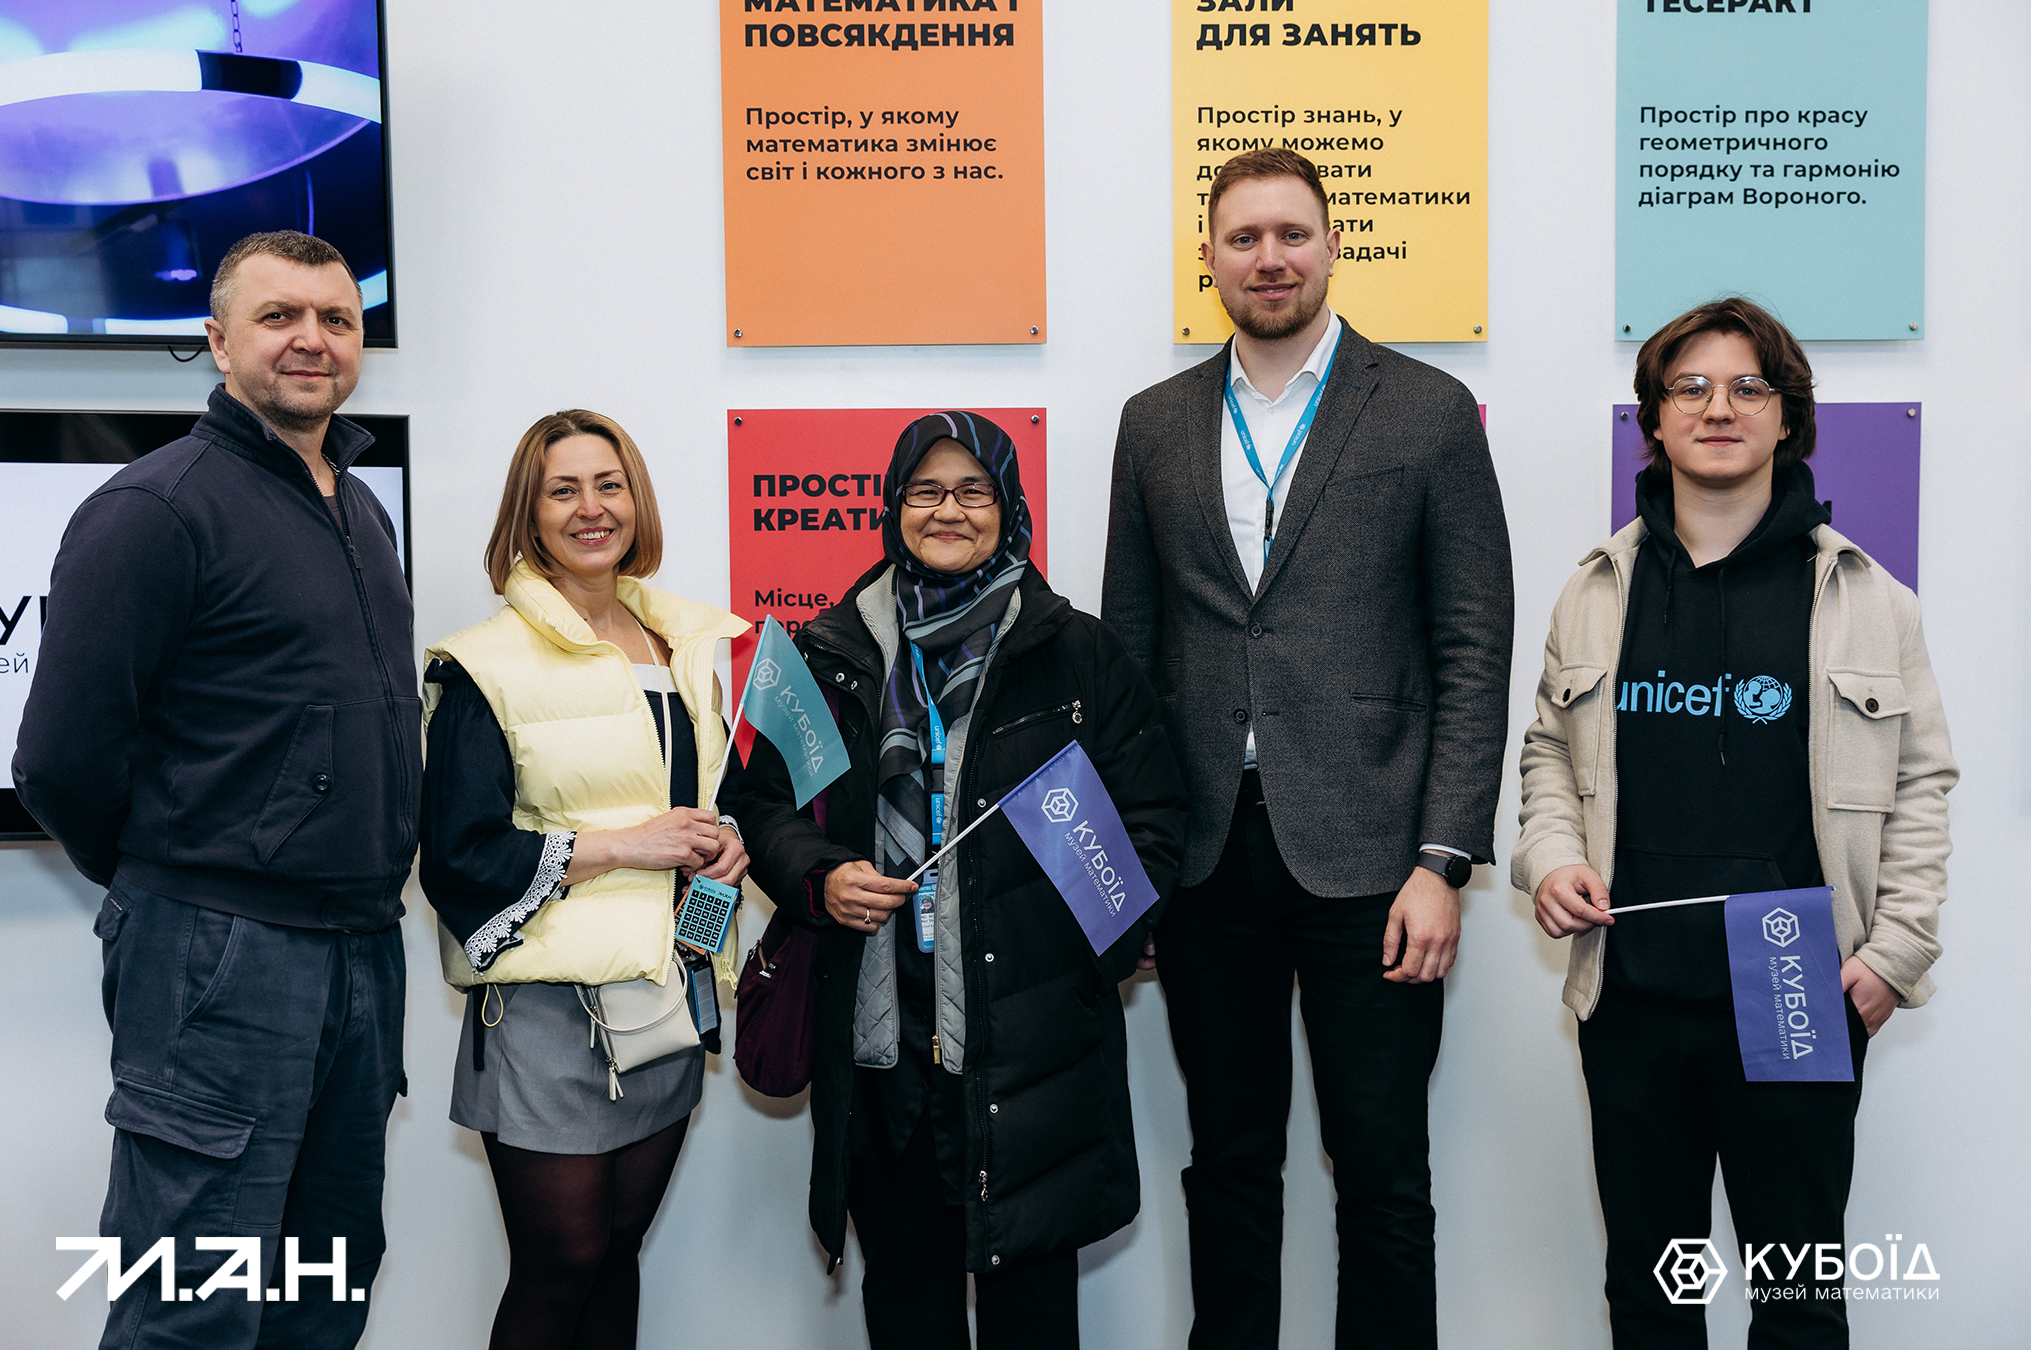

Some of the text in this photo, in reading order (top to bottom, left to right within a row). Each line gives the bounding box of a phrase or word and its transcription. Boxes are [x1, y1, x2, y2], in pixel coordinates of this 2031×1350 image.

[745, 23, 1014, 51] ПОВСЯКДЕННЯ
[1196, 23, 1421, 51] ДЛЯ ЗАНЯТЬ
[746, 106, 960, 129] Простір, у якому
[1198, 105, 1403, 127] Простір знань, у
[1640, 105, 1868, 128] Простір про красу
[746, 133, 997, 153] математика змінює
[1197, 137, 1384, 151] якому можемо
[1640, 137, 1828, 155] геометричного
[746, 161, 1004, 181] світ і кожного з нас.
[1639, 159, 1900, 182] порядку та гармонію
[1638, 187, 1867, 209] діаграм Вороного.
[1198, 214, 1203, 233] і
[753, 473, 882, 497] ПРОСТІ
[753, 507, 884, 531] КРЕАТИ
[755, 588, 834, 609] Місце,
[773, 696, 814, 777] музей математики
[780, 685, 824, 773] КУБОЇД
[1064, 832, 1116, 917] музей математики
[1072, 820, 1126, 912] КУБОЇД
[1768, 956, 1790, 1060] музей математики
[1780, 955, 1817, 1060] КУБОЇД
